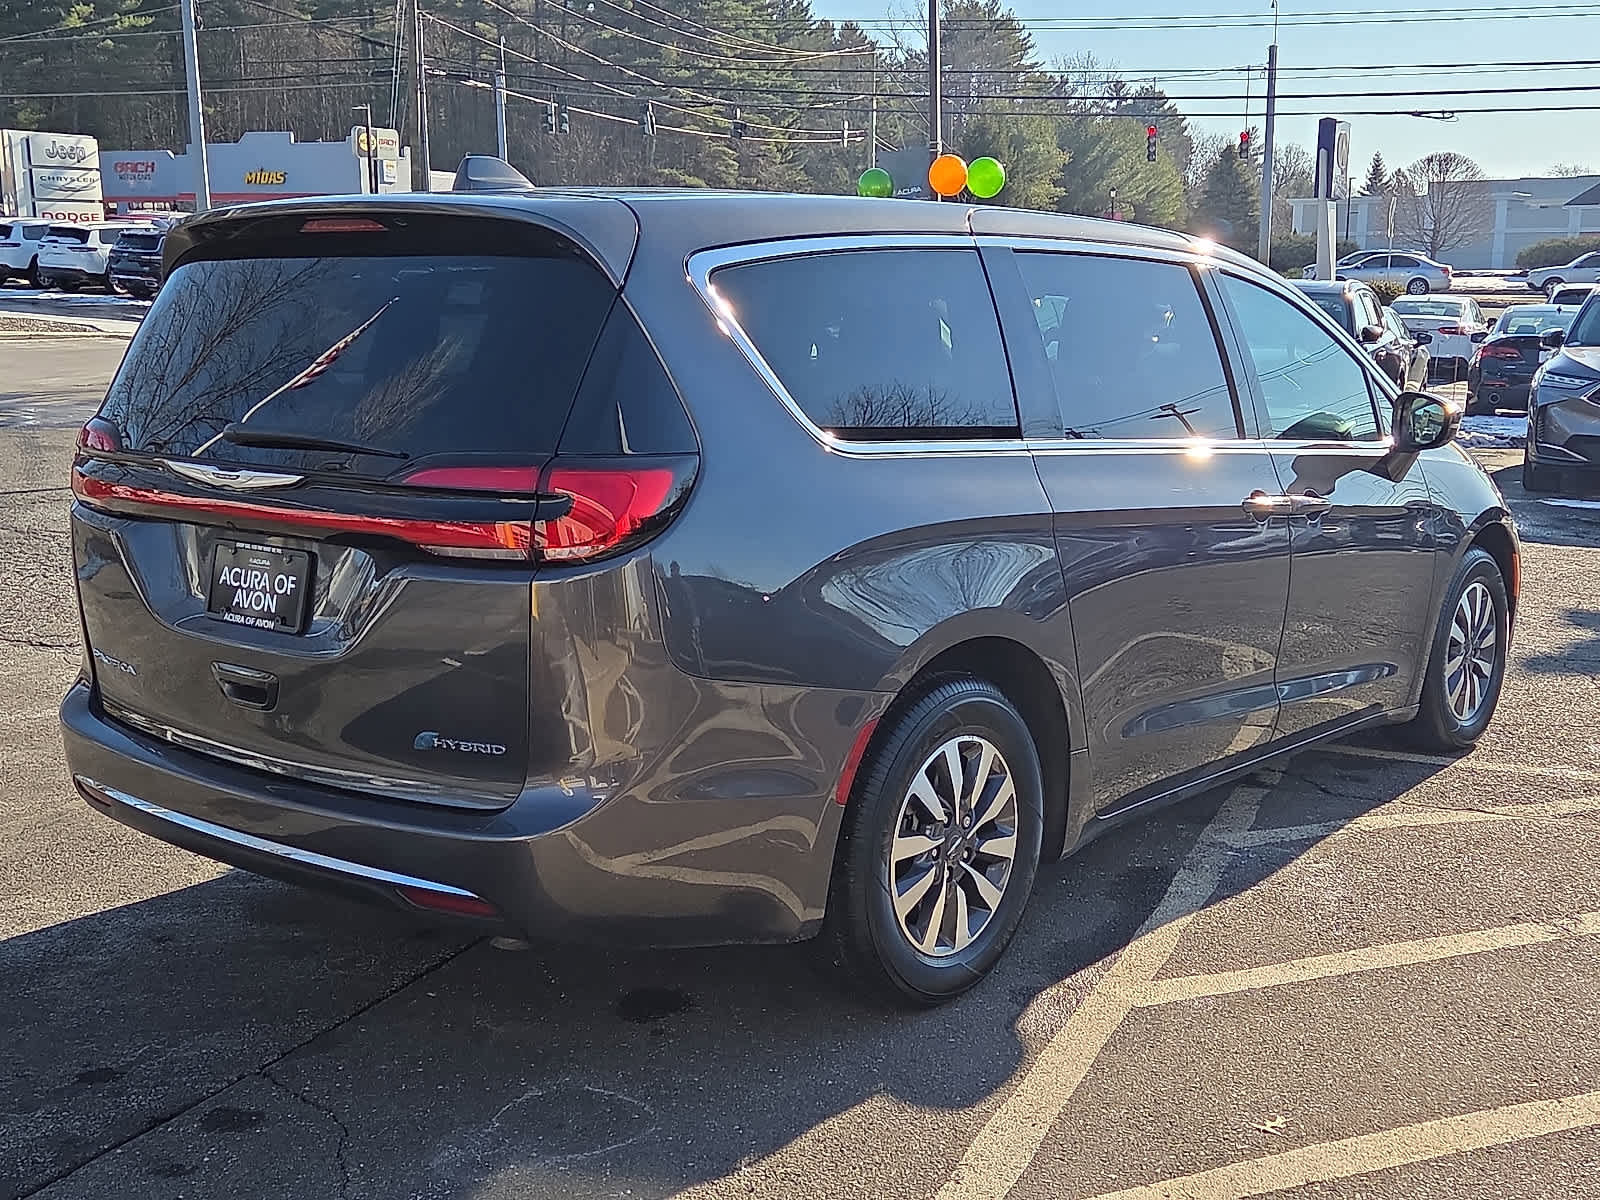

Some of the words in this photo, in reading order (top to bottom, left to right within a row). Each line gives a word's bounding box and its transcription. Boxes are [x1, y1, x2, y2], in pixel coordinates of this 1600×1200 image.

[45, 141, 86, 163] Jeep
[39, 174, 97, 184] CHRYSLER
[244, 168, 287, 185] MIDAS
[896, 186, 922, 196] ACURA
[41, 211, 101, 223] DODGE
[219, 566, 270, 592] ACURA
[274, 574, 297, 595] OF
[232, 588, 277, 613] AVON
[223, 612, 245, 625] ACURA
[245, 616, 256, 626] OF
[255, 617, 275, 630] AVON
